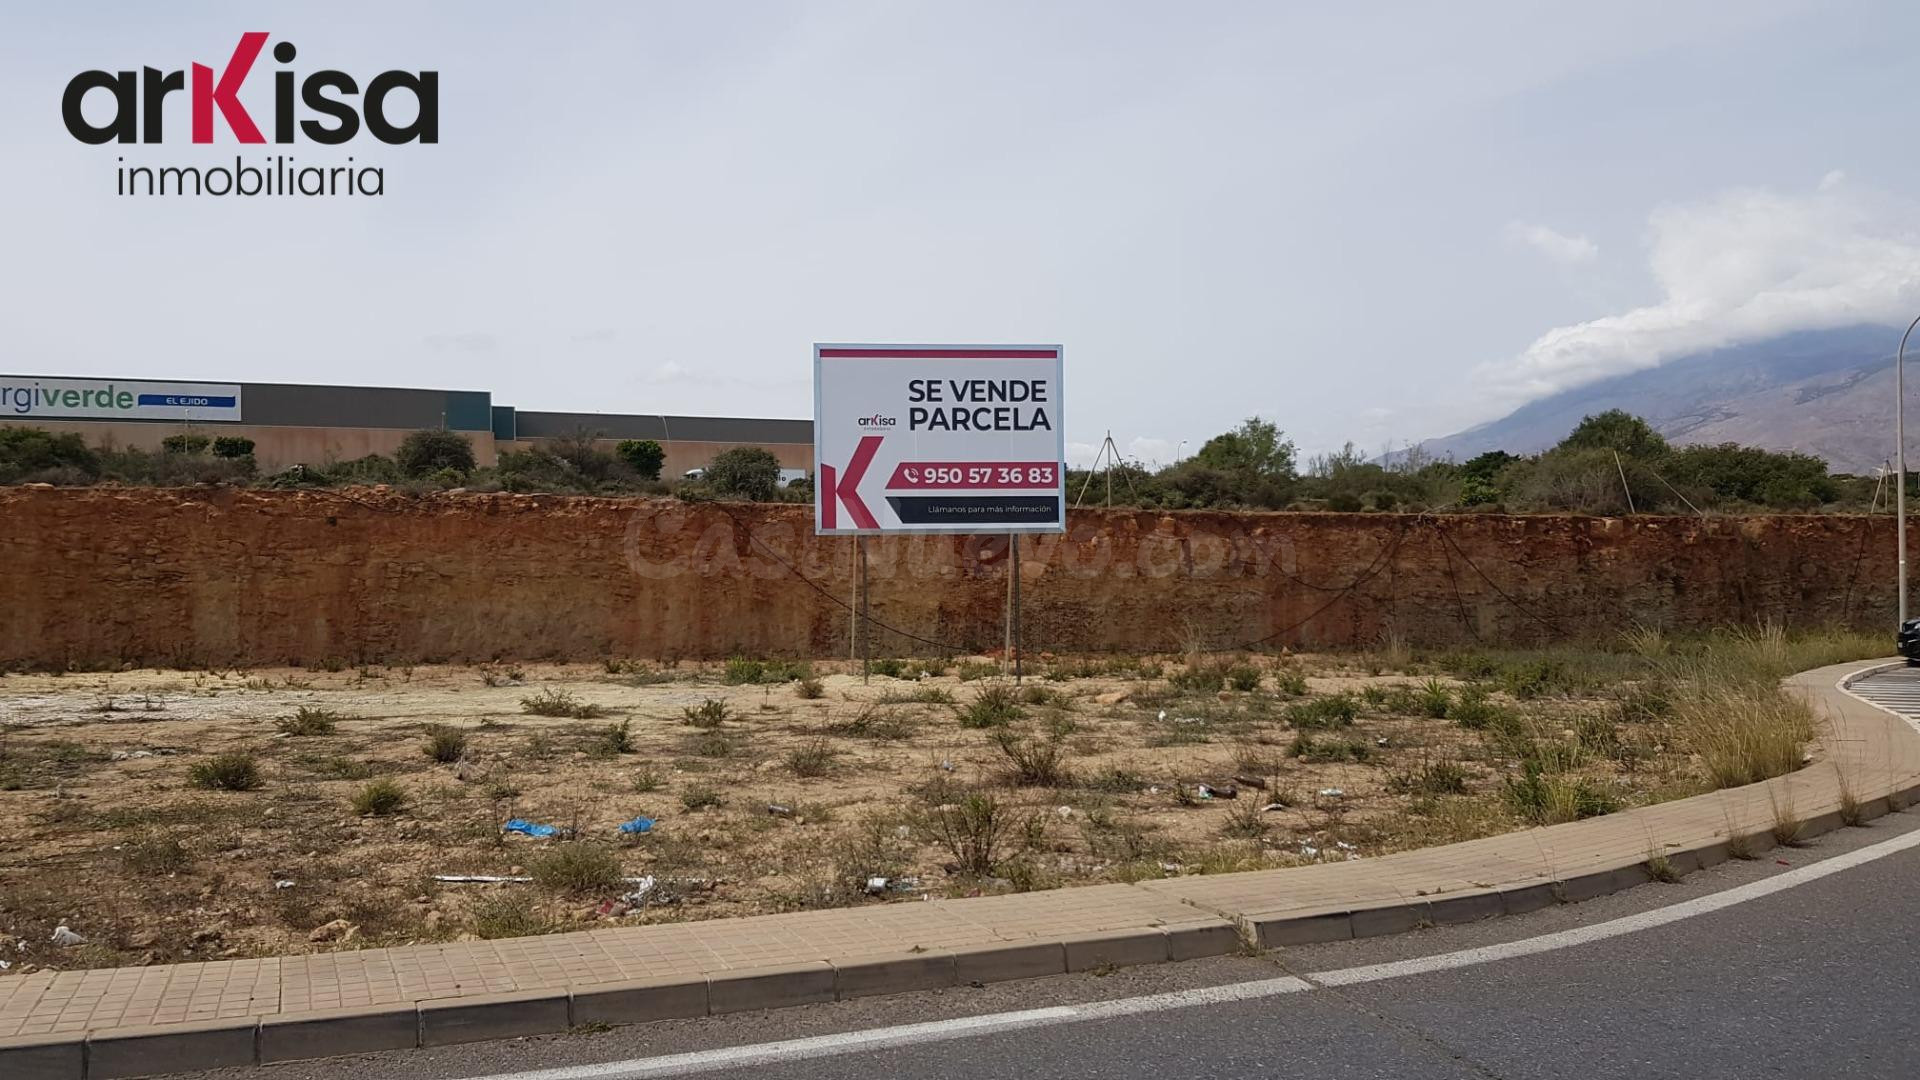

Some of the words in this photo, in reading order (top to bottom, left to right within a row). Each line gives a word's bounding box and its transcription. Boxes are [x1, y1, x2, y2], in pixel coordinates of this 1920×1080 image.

[2, 382, 134, 413] rgiverde
[908, 380, 942, 402] SE
[949, 380, 1047, 402] VENDE
[166, 397, 178, 405] EL
[180, 398, 208, 406] EJIDO
[909, 407, 1051, 431] PARCELA
[924, 468, 962, 483] 950
[968, 468, 992, 483] 57
[997, 468, 1022, 483] 36
[1028, 468, 1053, 483] 83
[928, 505, 966, 513] Llámanos
[968, 507, 985, 515] para
[987, 505, 1003, 513] más
[1005, 505, 1051, 513] información
